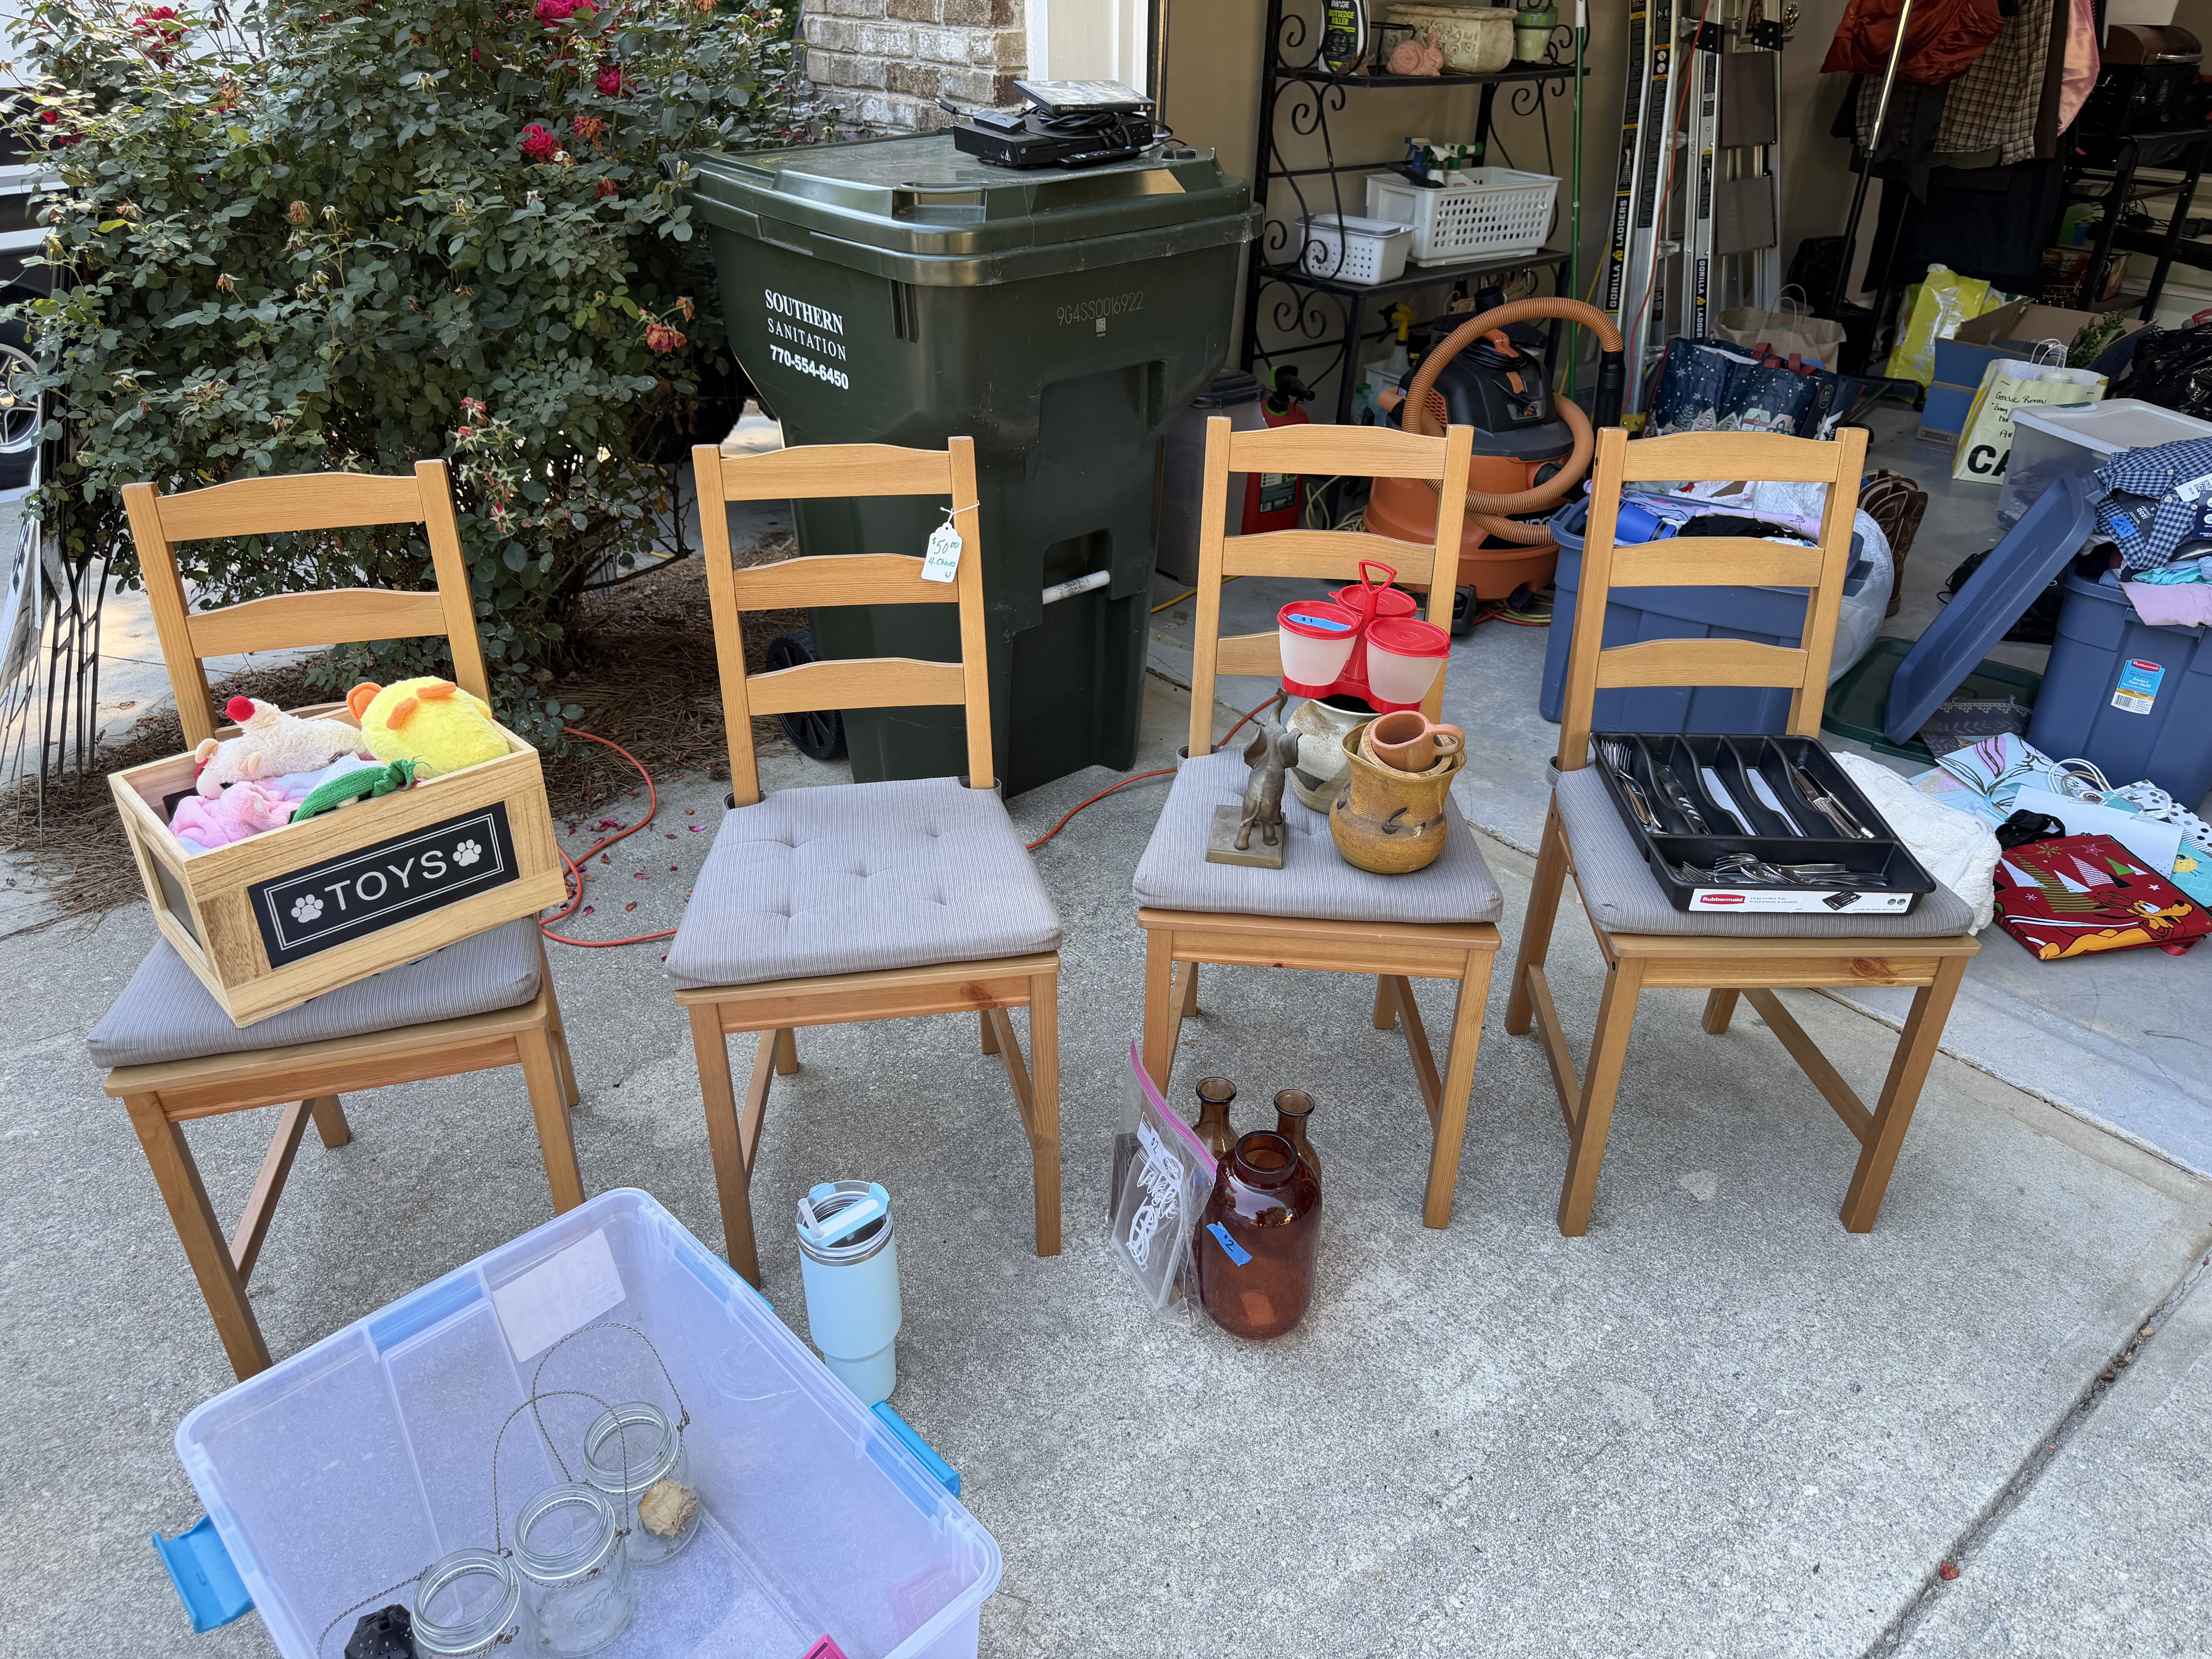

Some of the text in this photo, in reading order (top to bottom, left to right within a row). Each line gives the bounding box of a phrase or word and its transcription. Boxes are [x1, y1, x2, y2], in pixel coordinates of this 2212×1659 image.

[1610, 199, 1628, 307] GORILLA LADDERS
[765, 289, 843, 336] SOUTHERN
[768, 318, 846, 361] SANITATION
[770, 344, 849, 390] 770-554-6450
[2137, 508, 2148, 519] IZOD
[325, 850, 447, 910] TOYS
[1151, 1138, 1158, 1154] $2
[1224, 1235, 1234, 1252] $2
